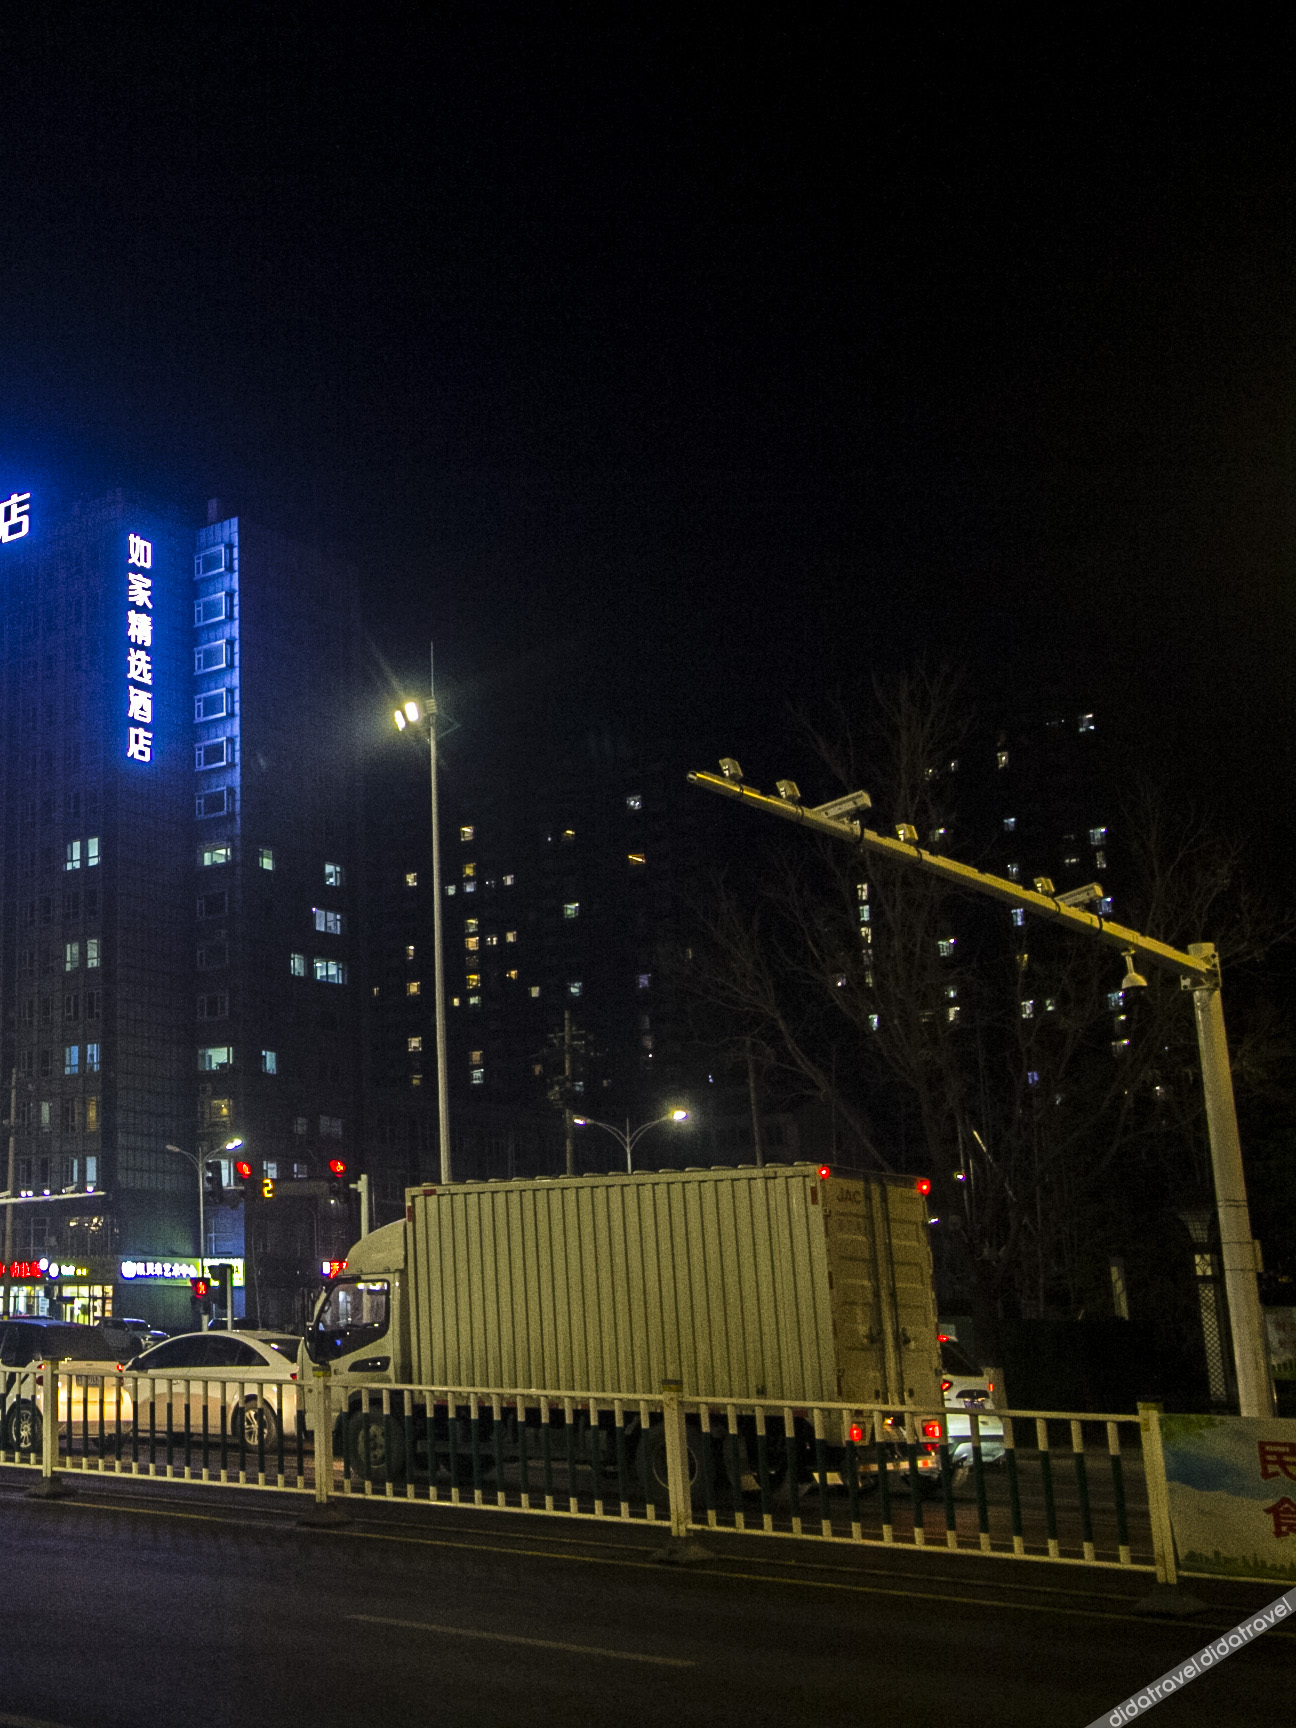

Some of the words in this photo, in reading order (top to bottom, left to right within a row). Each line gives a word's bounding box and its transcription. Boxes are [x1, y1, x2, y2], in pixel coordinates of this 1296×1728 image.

[127, 533, 153, 762] 如家精选酒店
[262, 1178, 274, 1198] 2
[836, 1187, 861, 1204] JAC
[1257, 1440, 1296, 1482] 民
